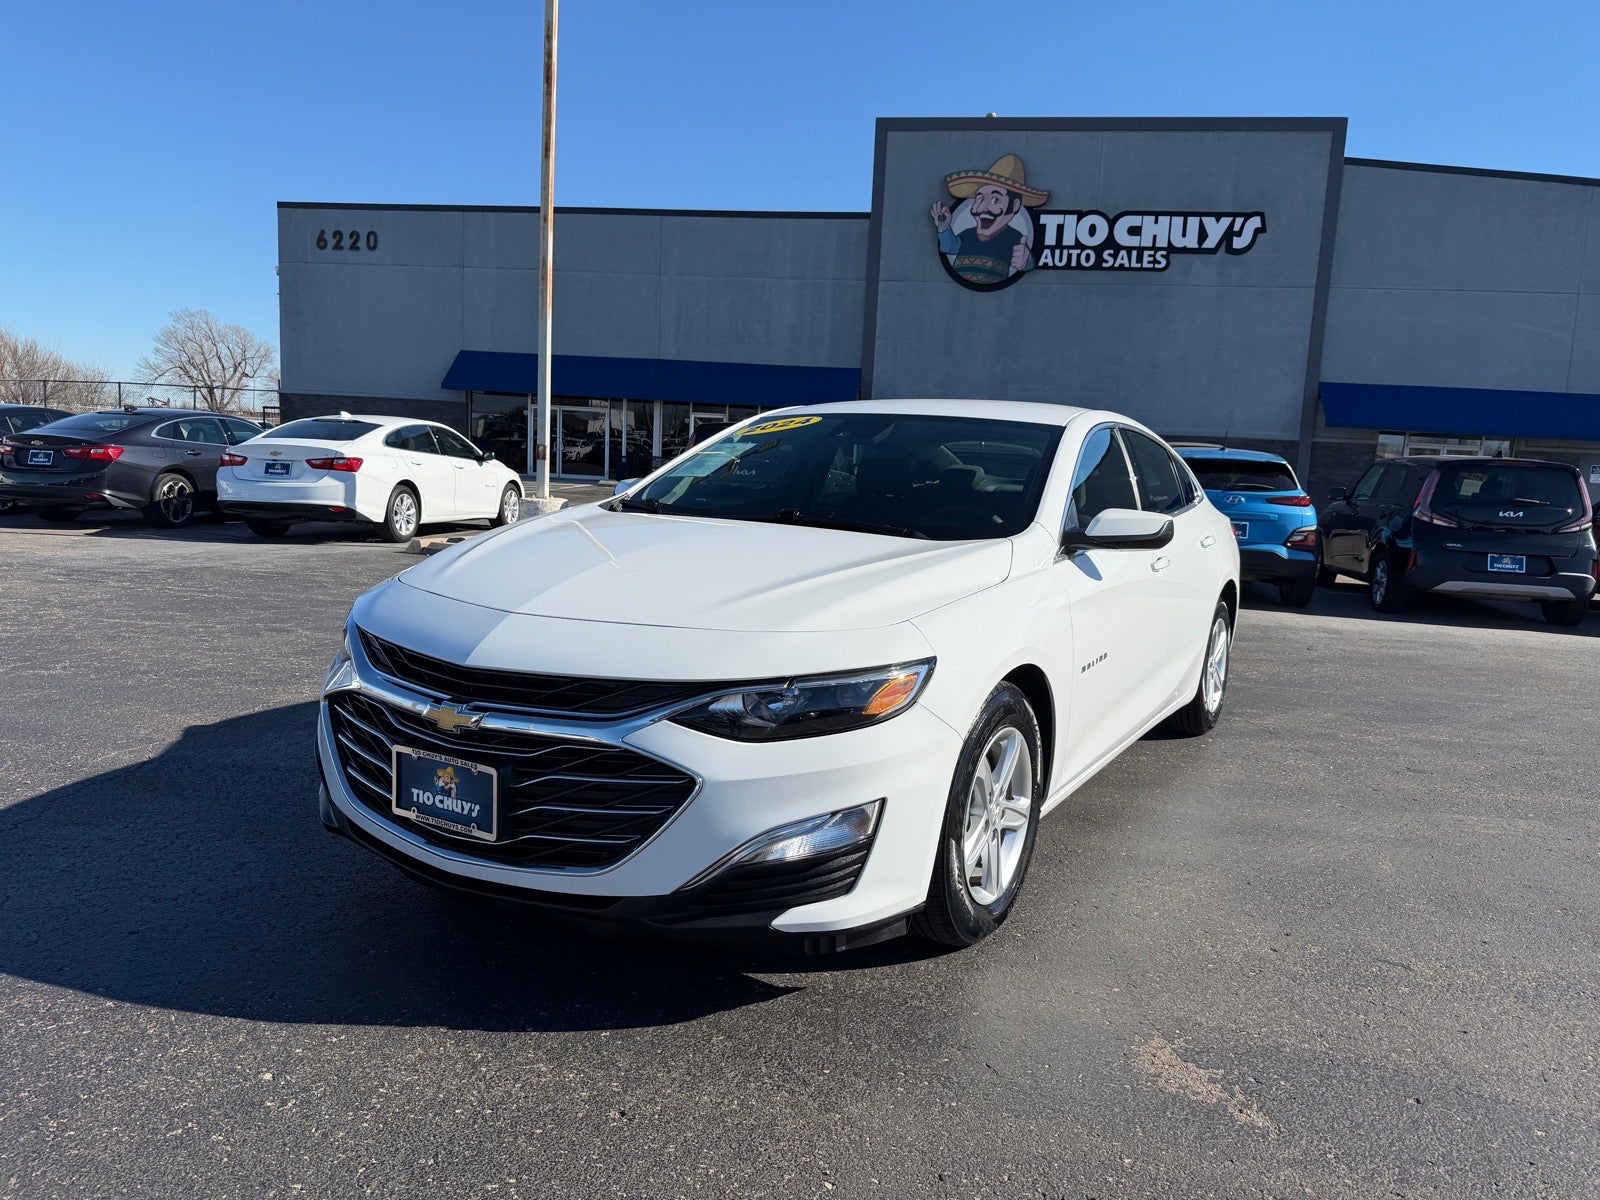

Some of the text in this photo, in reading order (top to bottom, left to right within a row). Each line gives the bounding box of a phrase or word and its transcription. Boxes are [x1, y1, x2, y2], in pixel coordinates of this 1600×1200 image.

[316, 229, 378, 251] 6220
[1039, 214, 1262, 249] TIO CHUY'S
[1038, 249, 1168, 269] AUTO SALES
[1498, 510, 1524, 518] KIA
[444, 756, 459, 765] AUTO
[460, 760, 478, 770] SALES
[411, 787, 480, 818] TIO CHUY'S
